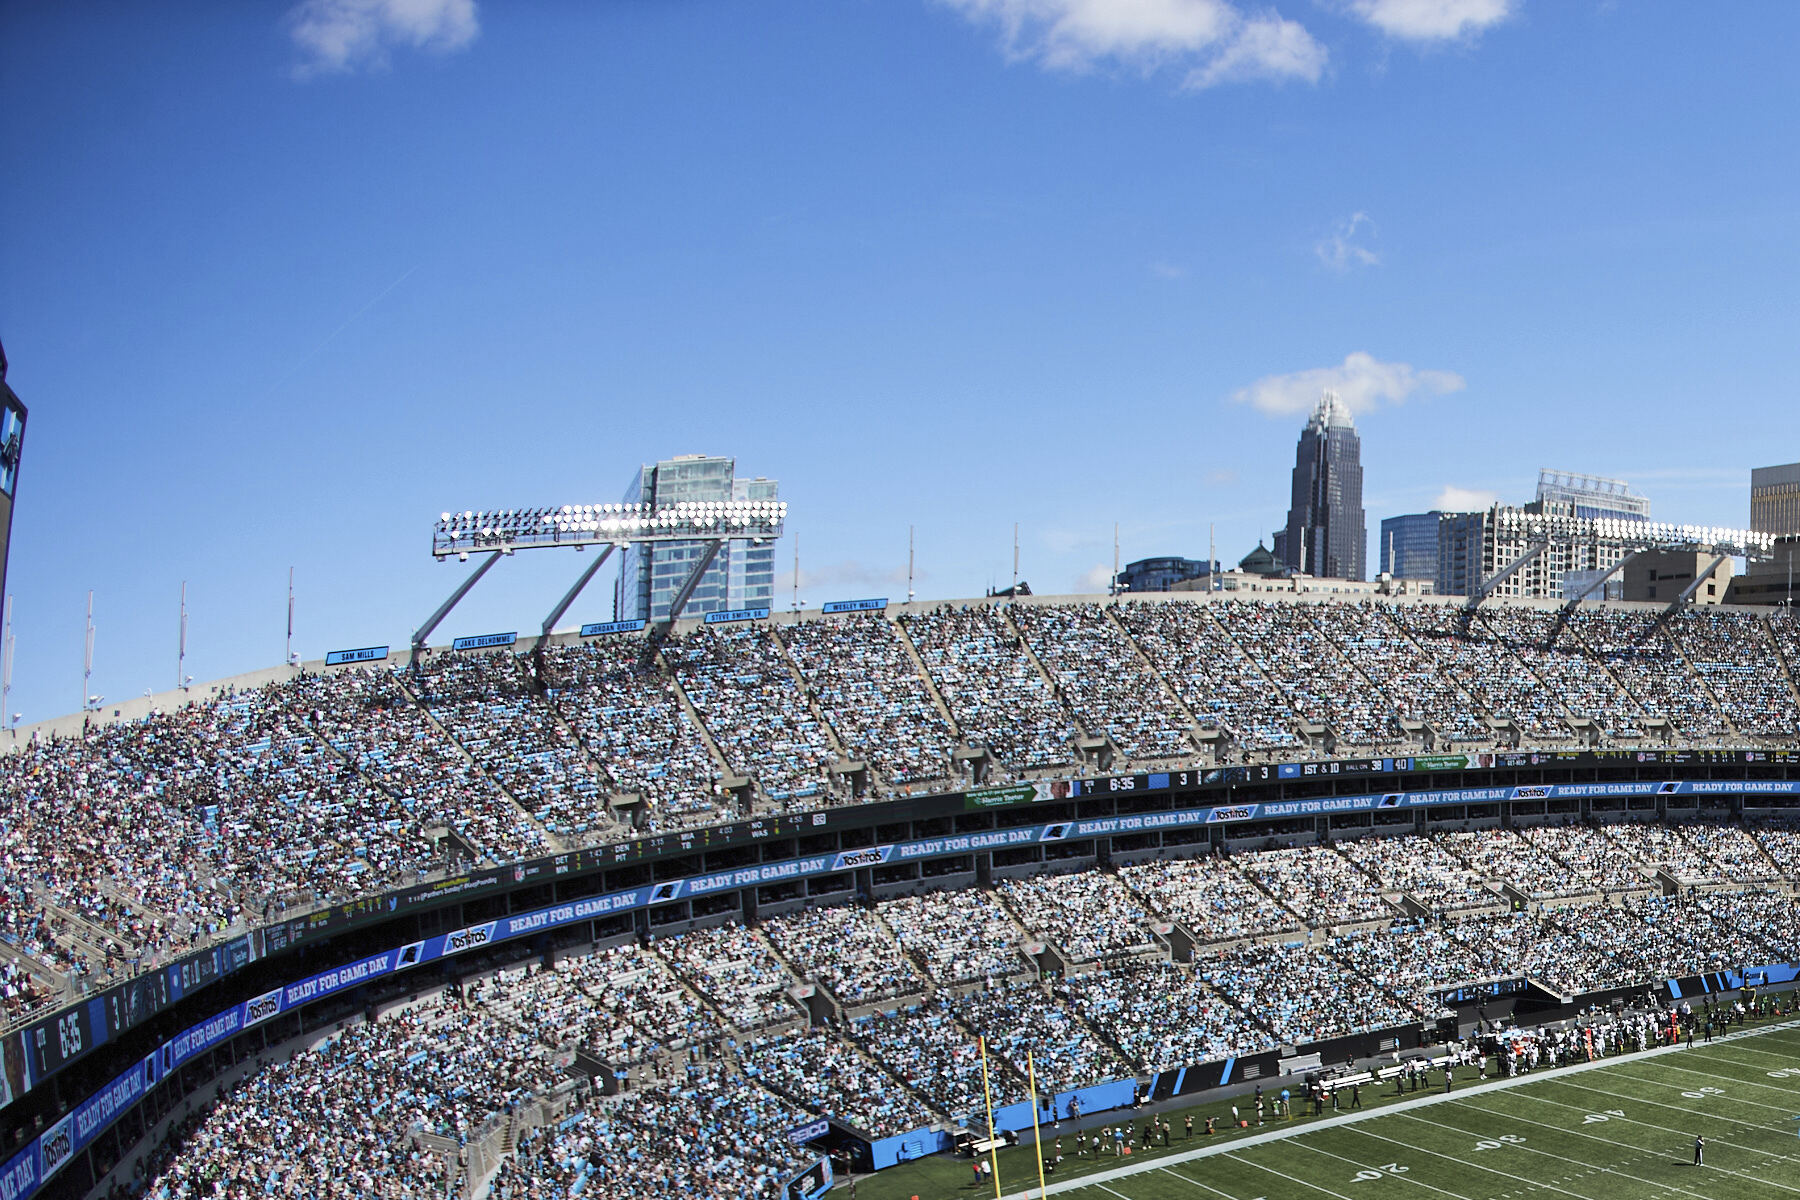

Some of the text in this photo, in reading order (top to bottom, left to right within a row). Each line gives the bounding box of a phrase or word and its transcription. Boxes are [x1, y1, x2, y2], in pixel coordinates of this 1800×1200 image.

[859, 600, 879, 609] WALLS
[711, 612, 730, 622] STEVE
[731, 611, 751, 620] SMITH
[589, 623, 615, 633] JORDAN
[459, 635, 511, 648] JAKE DELHOMME
[341, 650, 374, 661] SAM MILLS
[1304, 763, 1318, 774] 1ST
[1320, 763, 1328, 773] &
[1330, 761, 1339, 773] 10
[1371, 759, 1383, 771] 38
[1394, 759, 1407, 770] 40
[1179, 773, 1188, 786] 3
[1261, 766, 1269, 780] 3
[1109, 778, 1135, 791] 6:35
[1692, 783, 1793, 791] READY FOR GAME DAY
[1078, 811, 1200, 833] READY FOR GAME DAY
[690, 859, 825, 892] READY FOR GAME DAY
[58, 1011, 82, 1059] 6:35
[1680, 1086, 1726, 1099] 50
[1588, 1108, 1626, 1124] 40
[787, 1120, 830, 1144] GEICO
[1483, 1134, 1527, 1150] 30
[1356, 1163, 1409, 1181] 20
